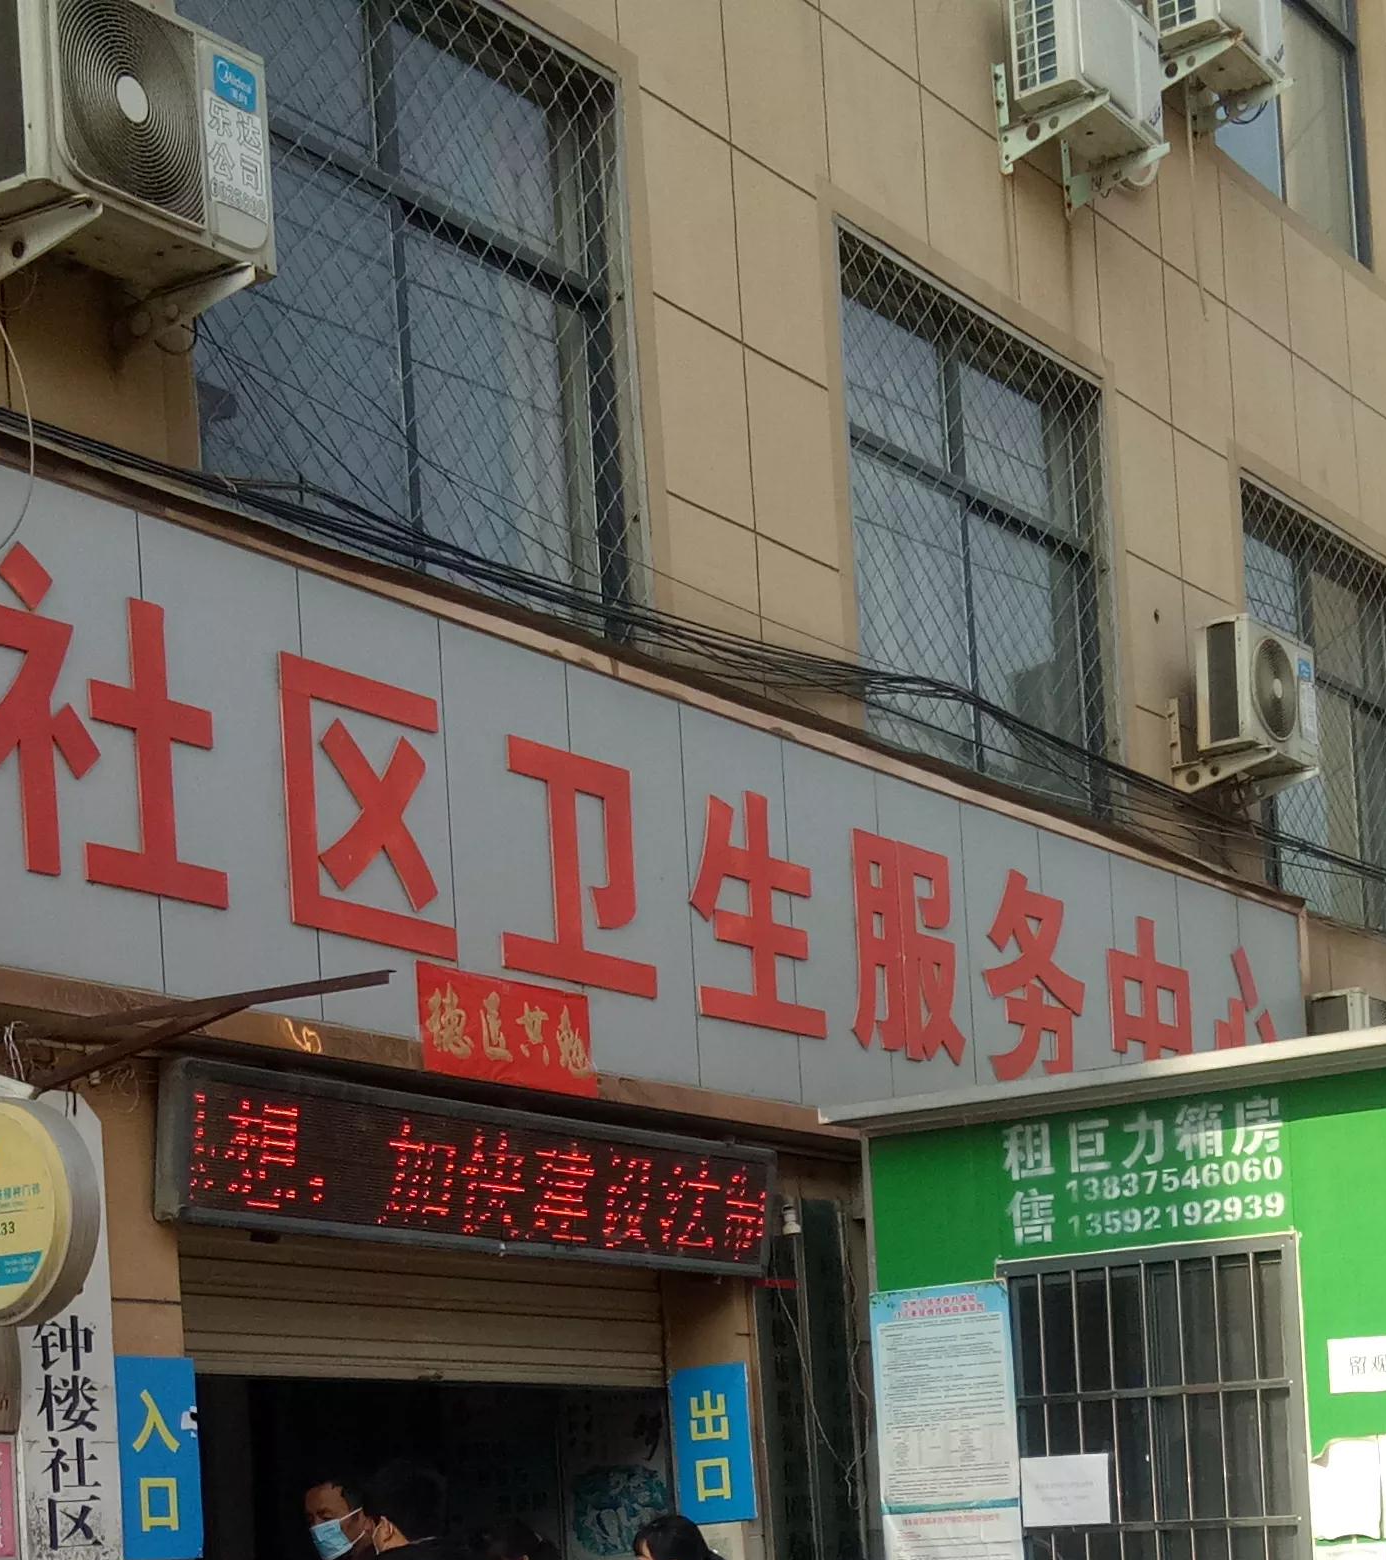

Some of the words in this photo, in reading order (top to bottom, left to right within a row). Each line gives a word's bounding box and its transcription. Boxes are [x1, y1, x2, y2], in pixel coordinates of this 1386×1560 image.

[1065, 1156, 1284, 1202] 13837546060
[1067, 1191, 1286, 1239] 13592192939
[131, 1388, 181, 1533] 入口
[689, 1389, 734, 1503] 出口
